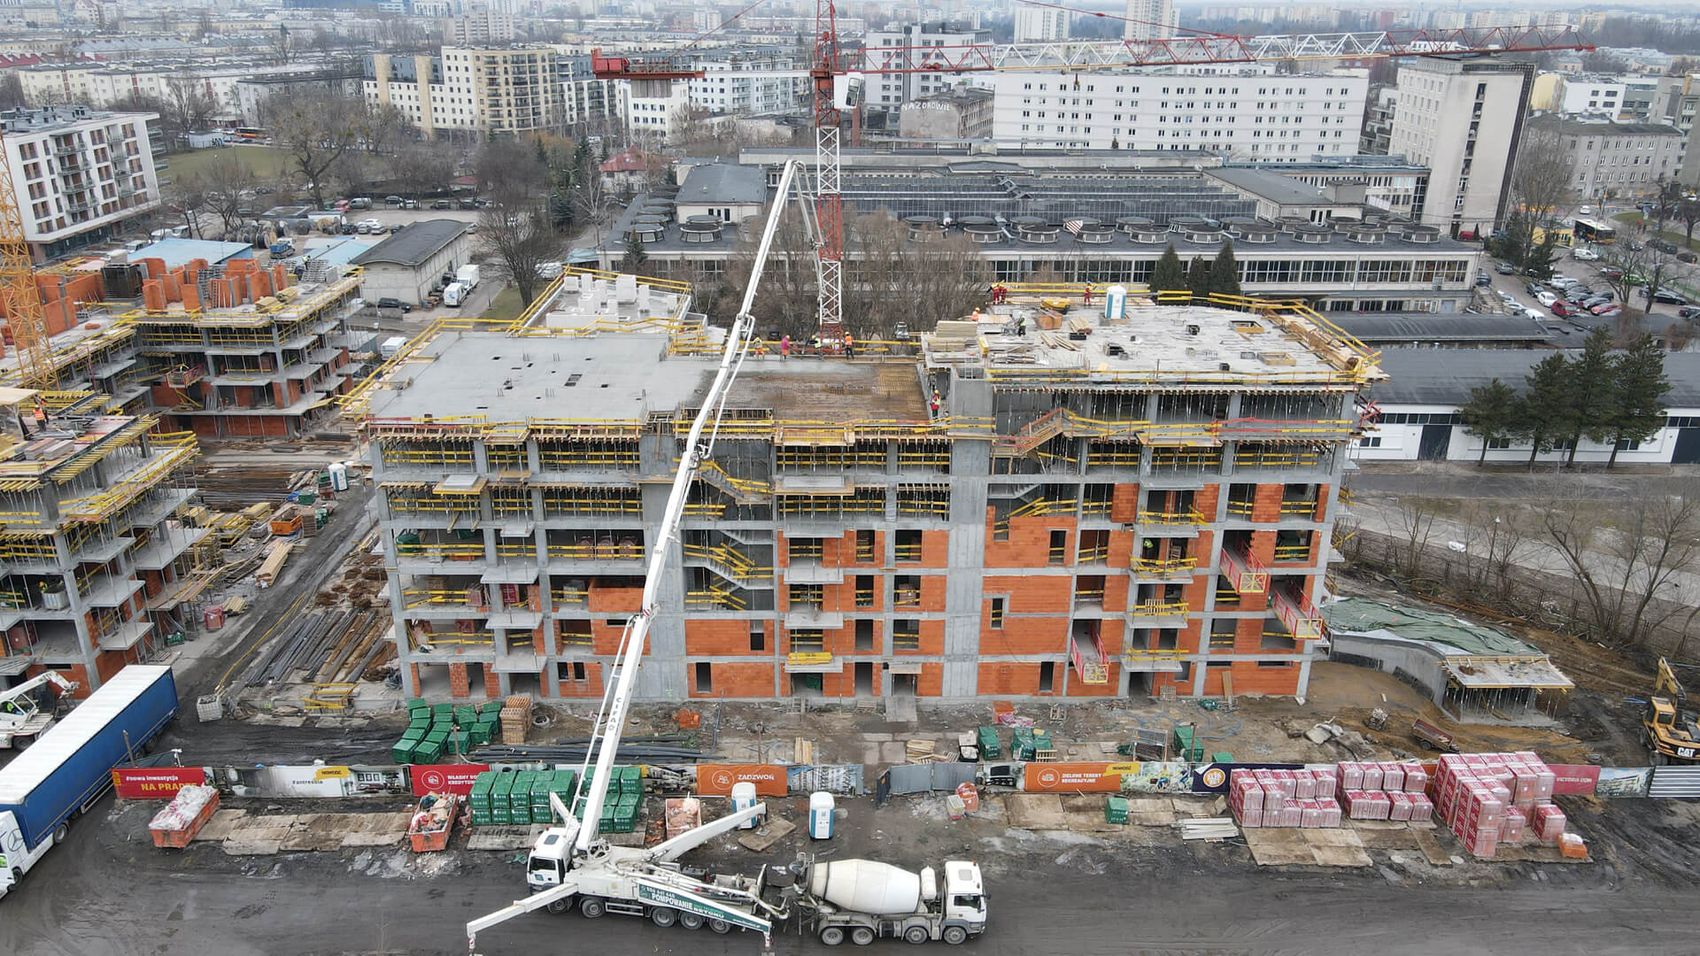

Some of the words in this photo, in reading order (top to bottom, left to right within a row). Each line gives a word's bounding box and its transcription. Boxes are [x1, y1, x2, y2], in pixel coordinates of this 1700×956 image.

[1677, 747, 1695, 757] CAT
[141, 783, 156, 791] NA
[652, 892, 693, 911] POMPOWANIE
